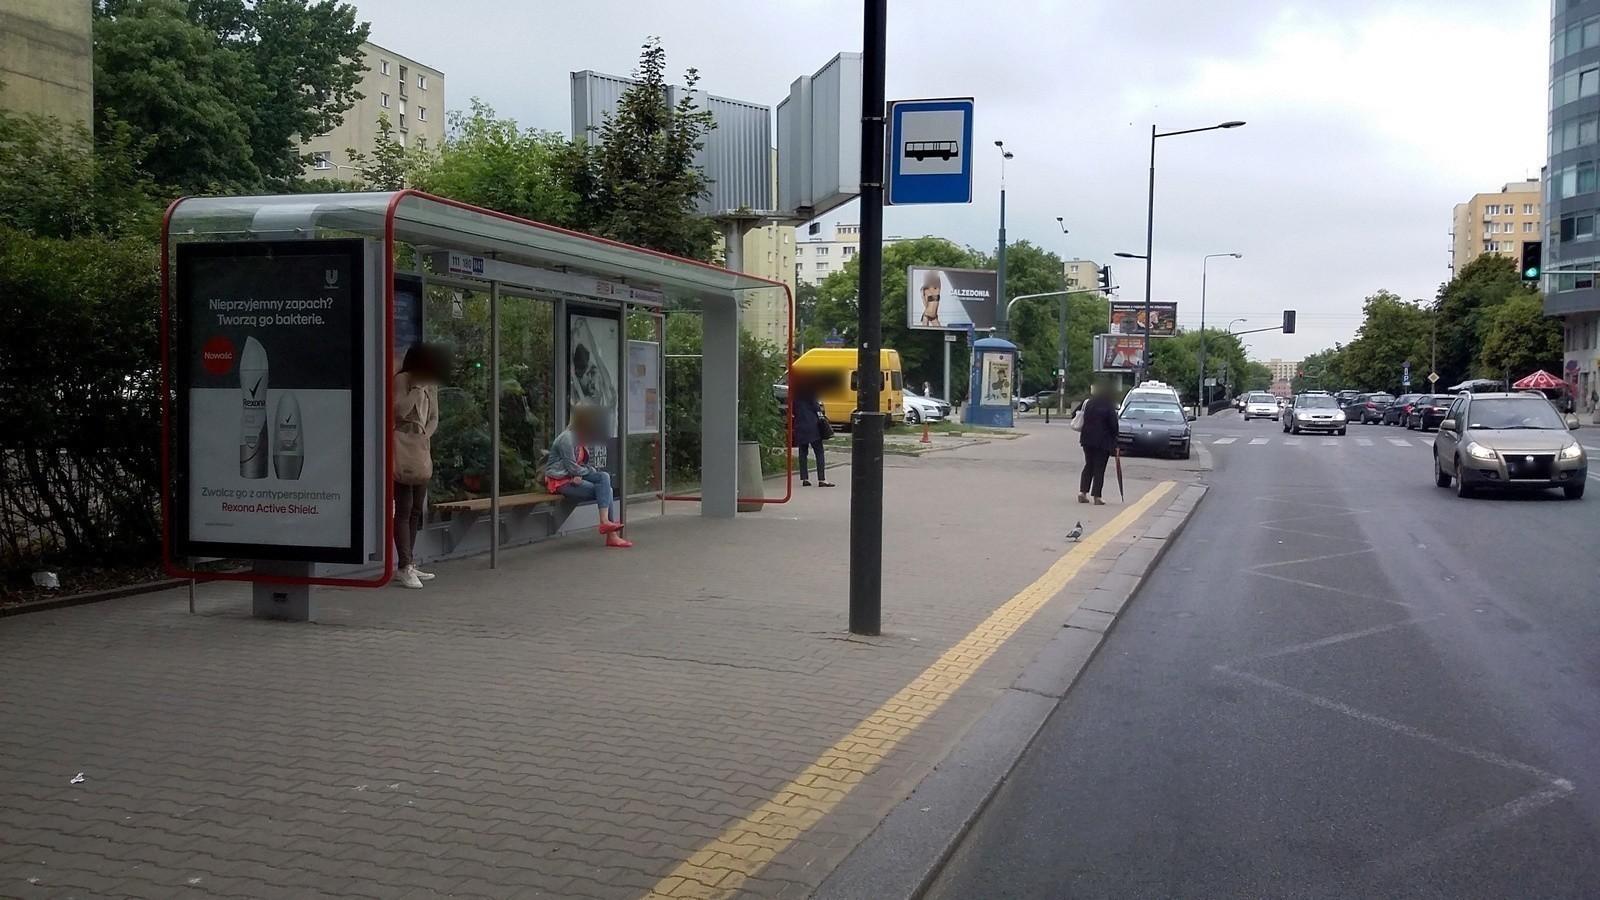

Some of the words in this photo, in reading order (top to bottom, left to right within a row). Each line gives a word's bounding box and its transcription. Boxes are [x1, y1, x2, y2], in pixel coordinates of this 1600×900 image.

[209, 298, 284, 312] Nieprzyjemny
[285, 297, 334, 311] zapach?
[217, 313, 257, 327] Tworzą
[258, 316, 274, 327] go
[275, 313, 326, 325] bakterie.
[204, 351, 233, 360] Nowość
[242, 399, 266, 408] Rexona
[235, 488, 248, 500] go
[255, 488, 341, 502] antyperspirantem
[222, 502, 255, 513] Rexona
[256, 503, 287, 514] Active
[288, 504, 320, 515] Shield.
